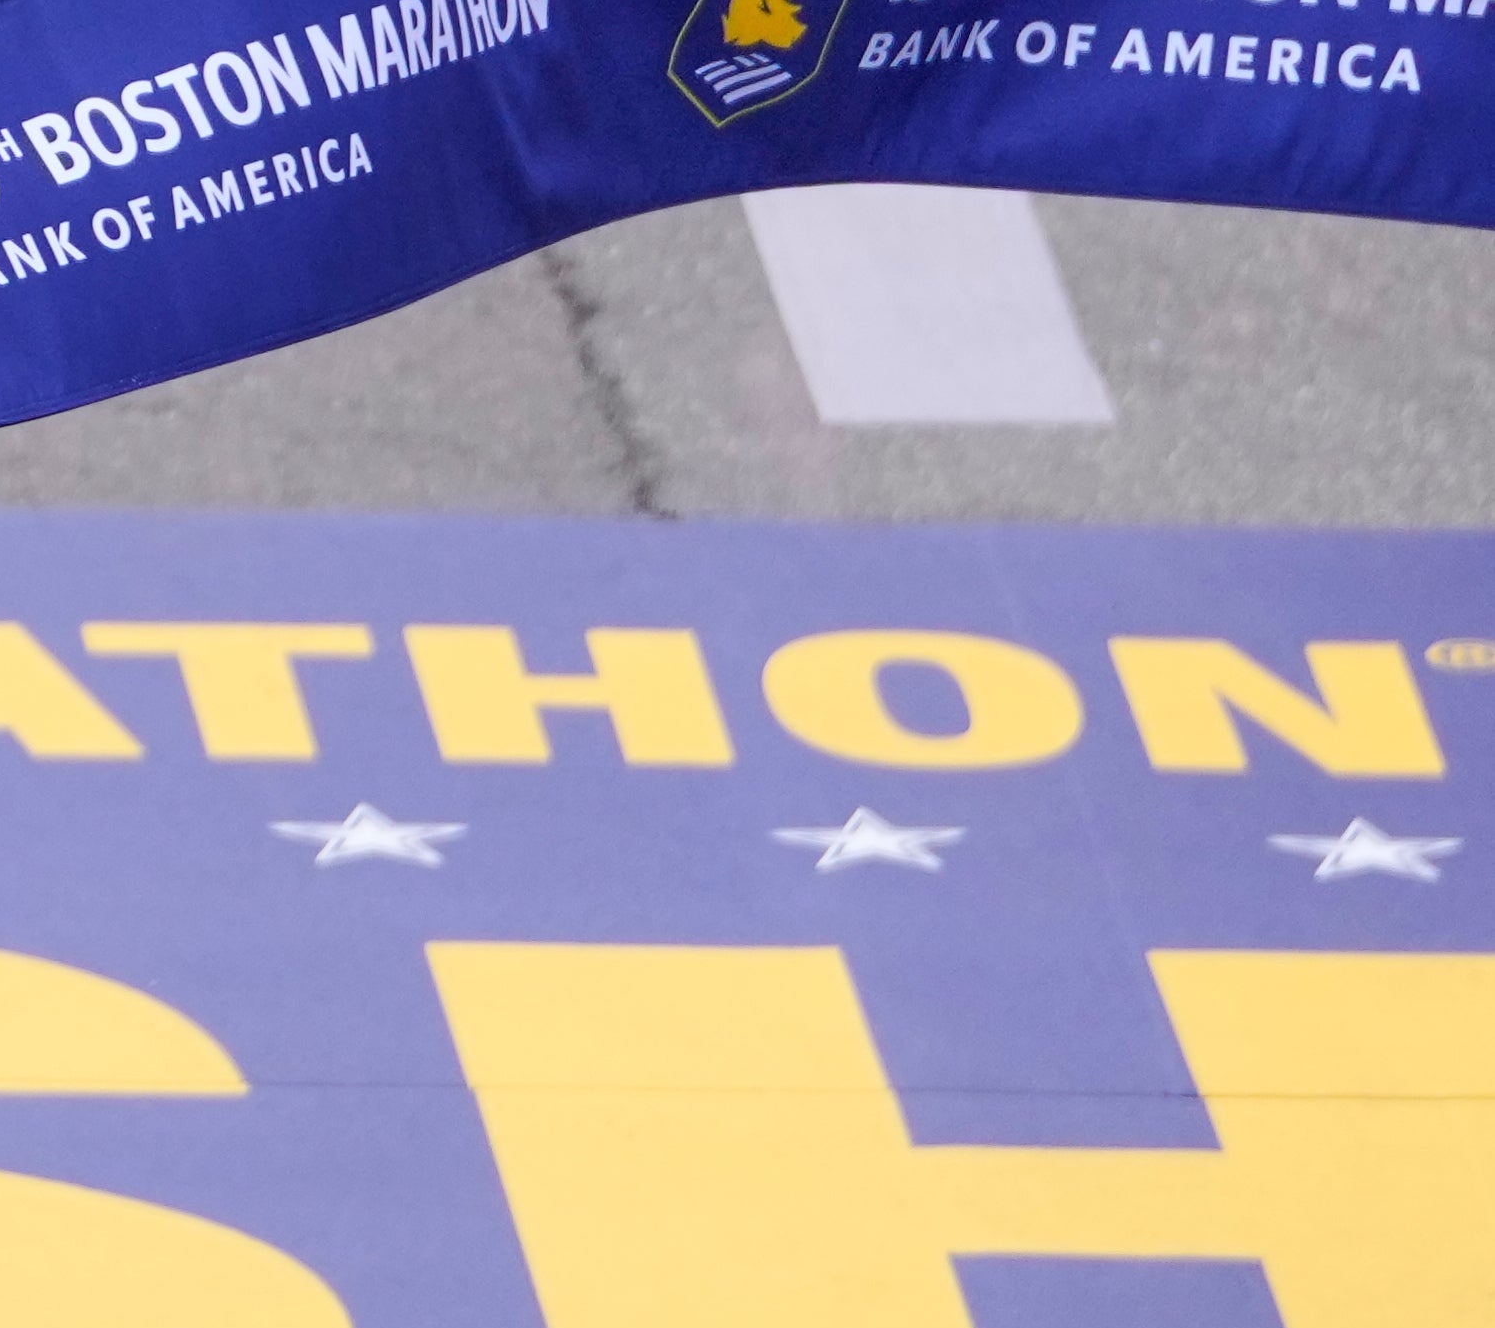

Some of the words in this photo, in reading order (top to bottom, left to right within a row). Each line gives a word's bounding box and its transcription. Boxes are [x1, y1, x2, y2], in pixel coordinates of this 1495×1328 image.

[21, 33, 312, 187] BOSTON
[857, 18, 1000, 70] BANK
[1015, 21, 1097, 68] OF
[1111, 27, 1422, 93] AMERICA
[92, 194, 157, 251] OF
[171, 131, 374, 231] AMERICA
